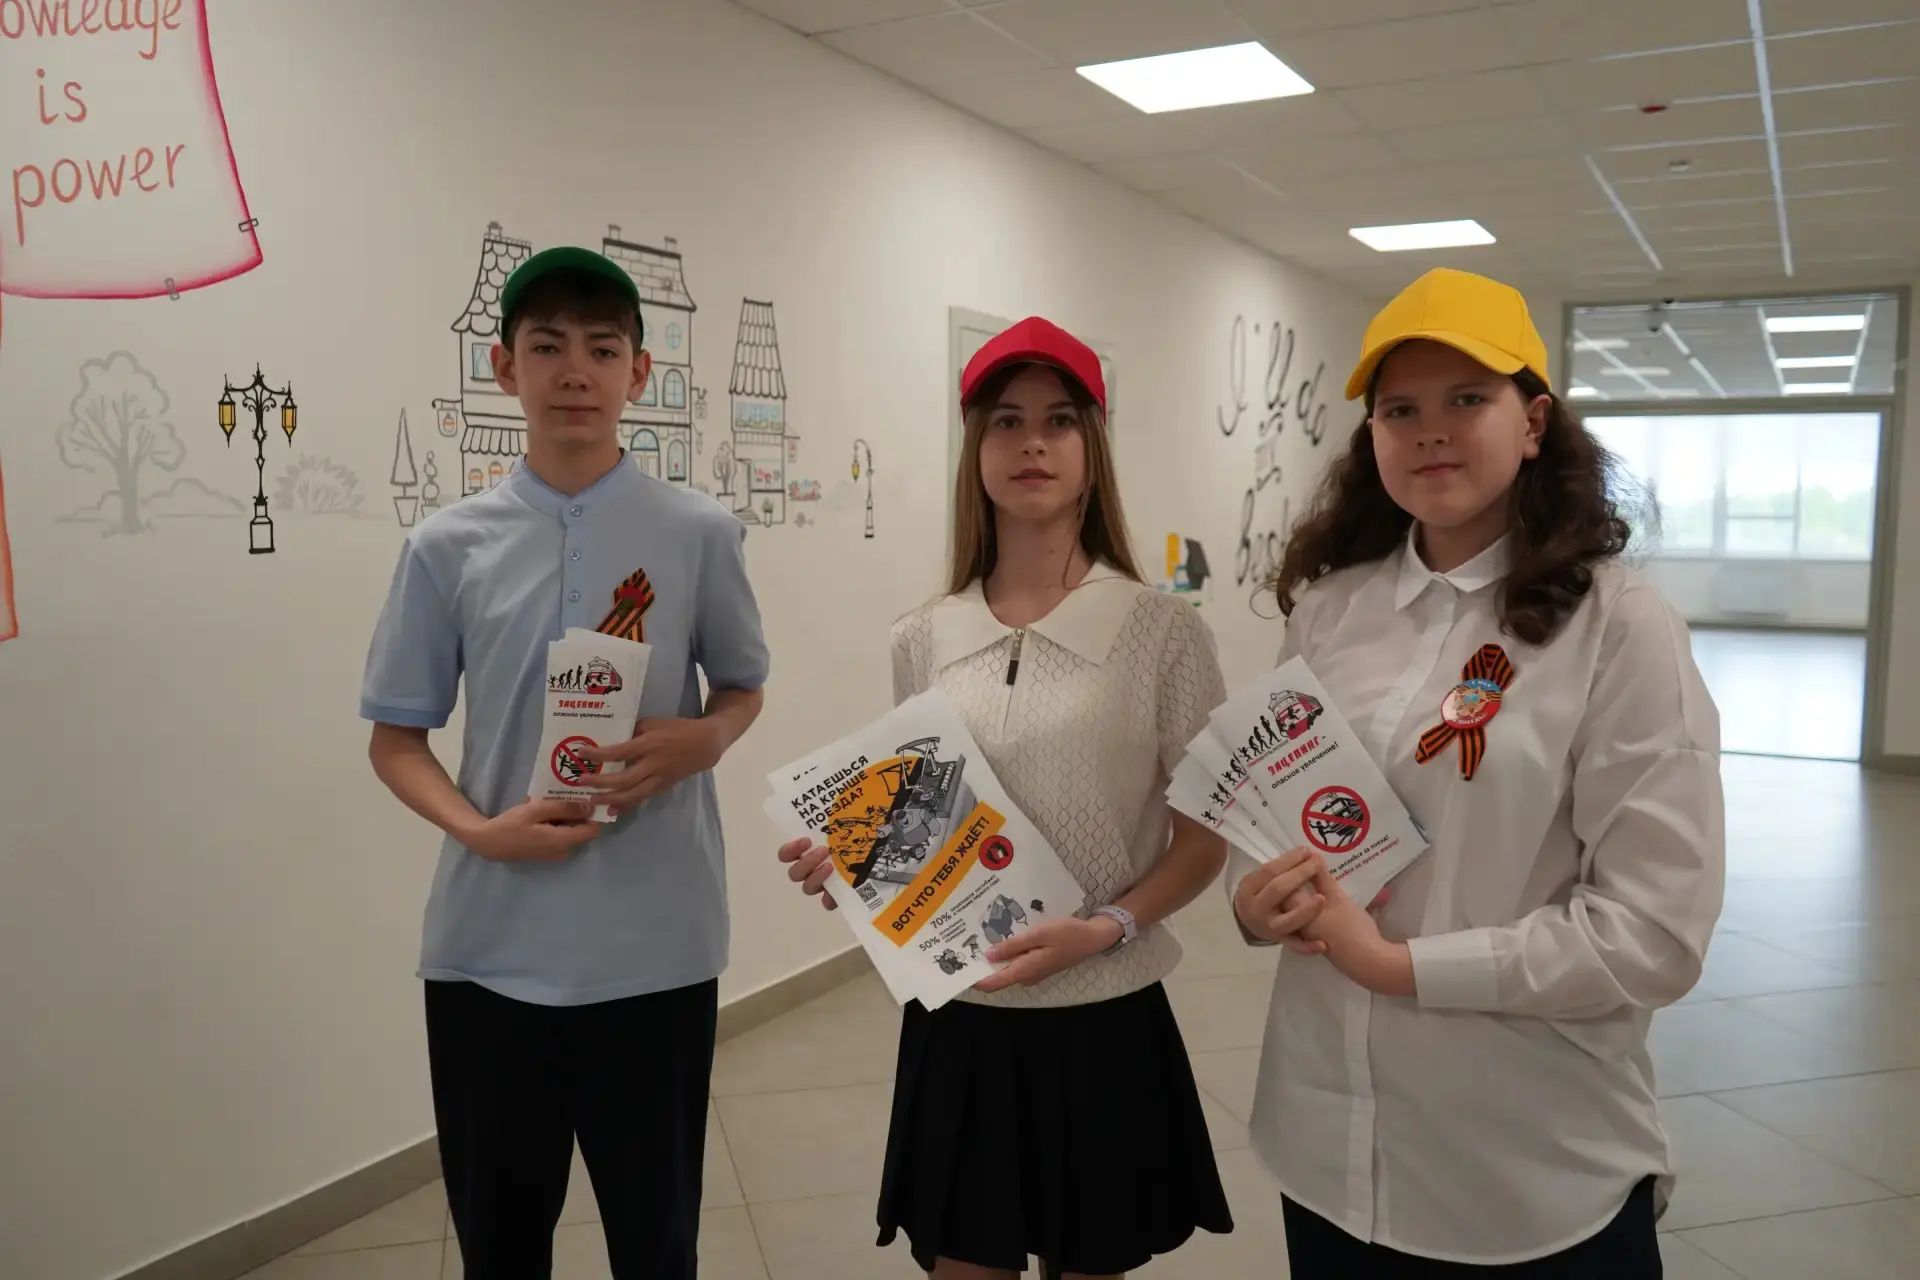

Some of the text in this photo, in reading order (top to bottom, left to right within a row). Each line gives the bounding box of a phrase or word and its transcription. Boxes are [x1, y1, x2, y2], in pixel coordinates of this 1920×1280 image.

[36, 68, 87, 125] is
[12, 144, 186, 248] power
[558, 699, 606, 709] ЗАЦЕПИНГ
[1267, 735, 1320, 776] ЗАЦЕПИНГ
[1271, 768, 1301, 789] опасное
[1299, 741, 1340, 771] увлечение!
[791, 755, 869, 809] КАТАЕШЬСЯ
[798, 803, 820, 819] НА
[819, 770, 868, 806] КРЫШЕ
[805, 787, 864, 830] ПОЕЗДА?
[891, 816, 990, 932] ВОТ ЧТО ТЕБЯ ЖДЁТ!
[919, 936, 941, 952] 50%
[930, 912, 952, 929] 70%
